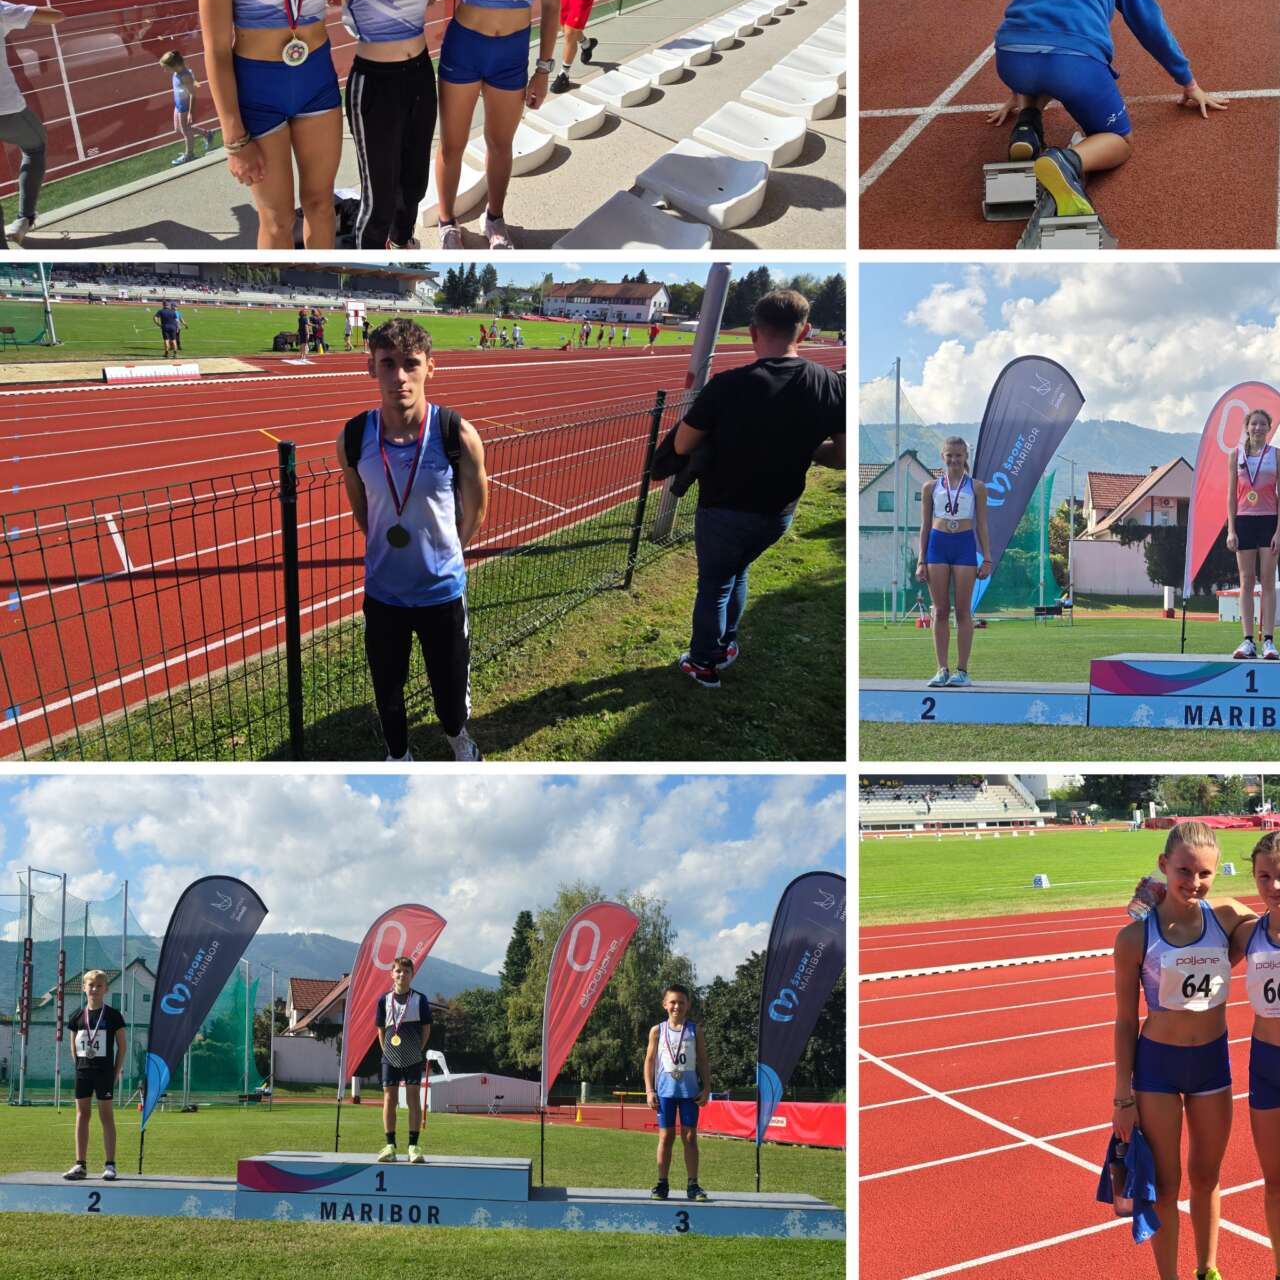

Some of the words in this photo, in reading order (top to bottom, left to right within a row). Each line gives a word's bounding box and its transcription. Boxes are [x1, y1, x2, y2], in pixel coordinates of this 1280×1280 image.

[1010, 426, 1041, 476] MARIBOR
[1244, 669, 1259, 694] 1
[920, 697, 936, 720] 2
[191, 940, 220, 986] MARIBOR
[798, 942, 826, 992] MARIBOR
[1176, 956, 1221, 967] poljane
[1181, 974, 1213, 999] 64
[374, 1170, 388, 1193] 1
[88, 1191, 101, 1213] 2
[320, 1202, 442, 1225] MARIBOR
[675, 1211, 692, 1234] 3
